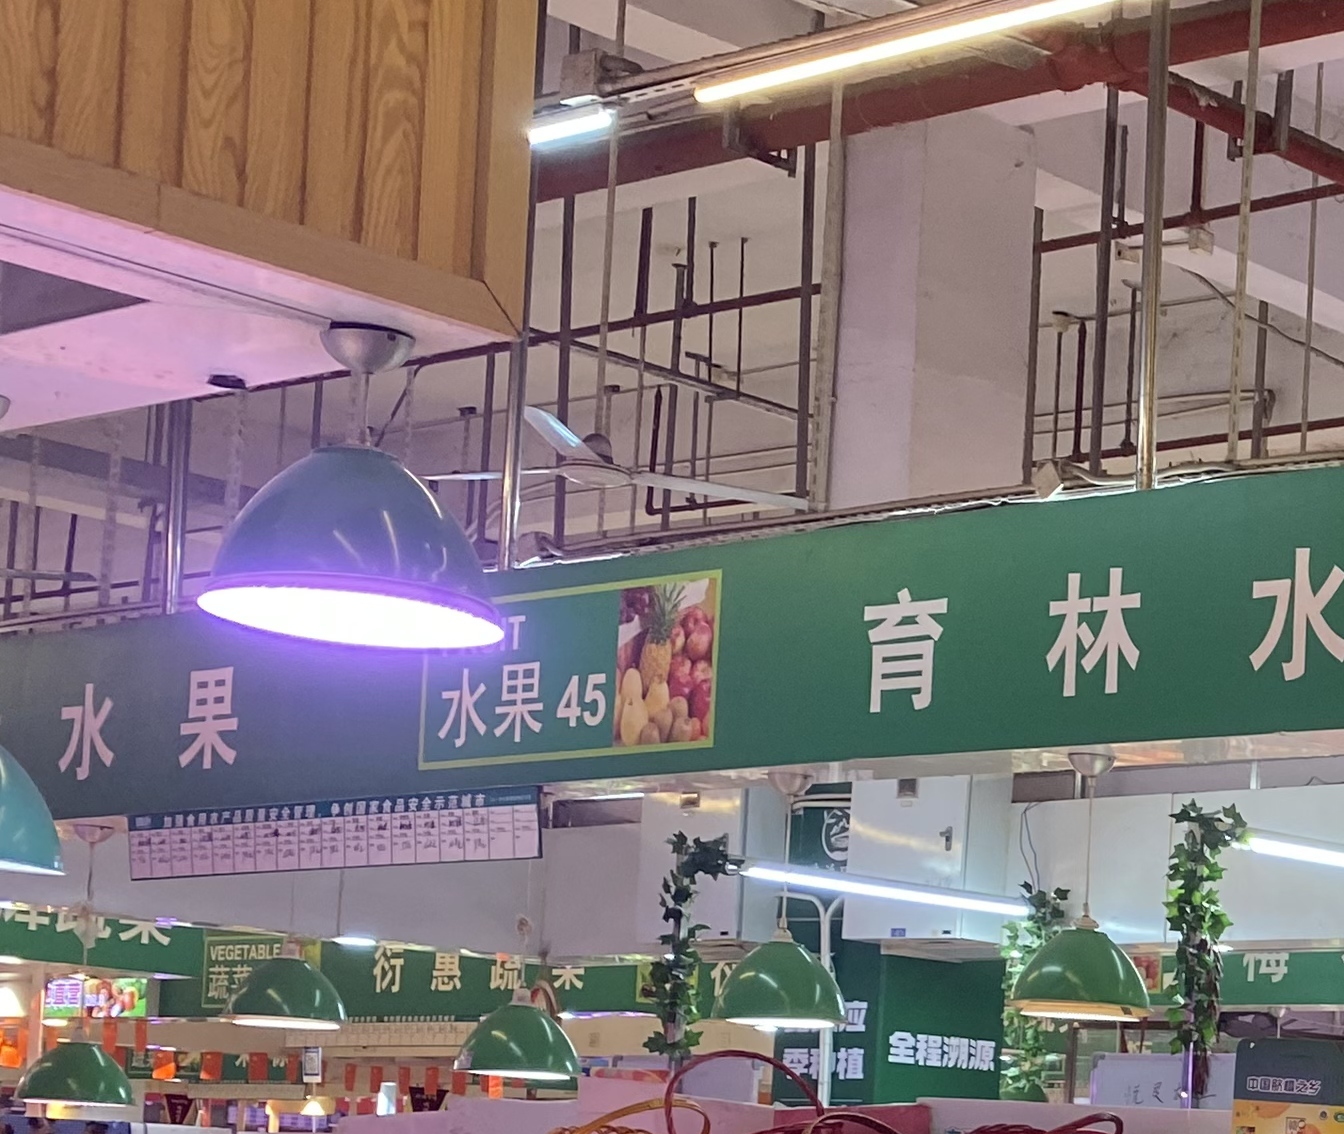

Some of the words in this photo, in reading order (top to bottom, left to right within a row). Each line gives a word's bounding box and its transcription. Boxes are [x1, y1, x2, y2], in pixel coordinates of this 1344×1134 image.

[57, 666, 240, 781] 水果
[437, 660, 543, 748] 水果
[556, 672, 608, 728] 45
[209, 942, 281, 961] VEGETABLE
[888, 1031, 996, 1071] 全程溯源
